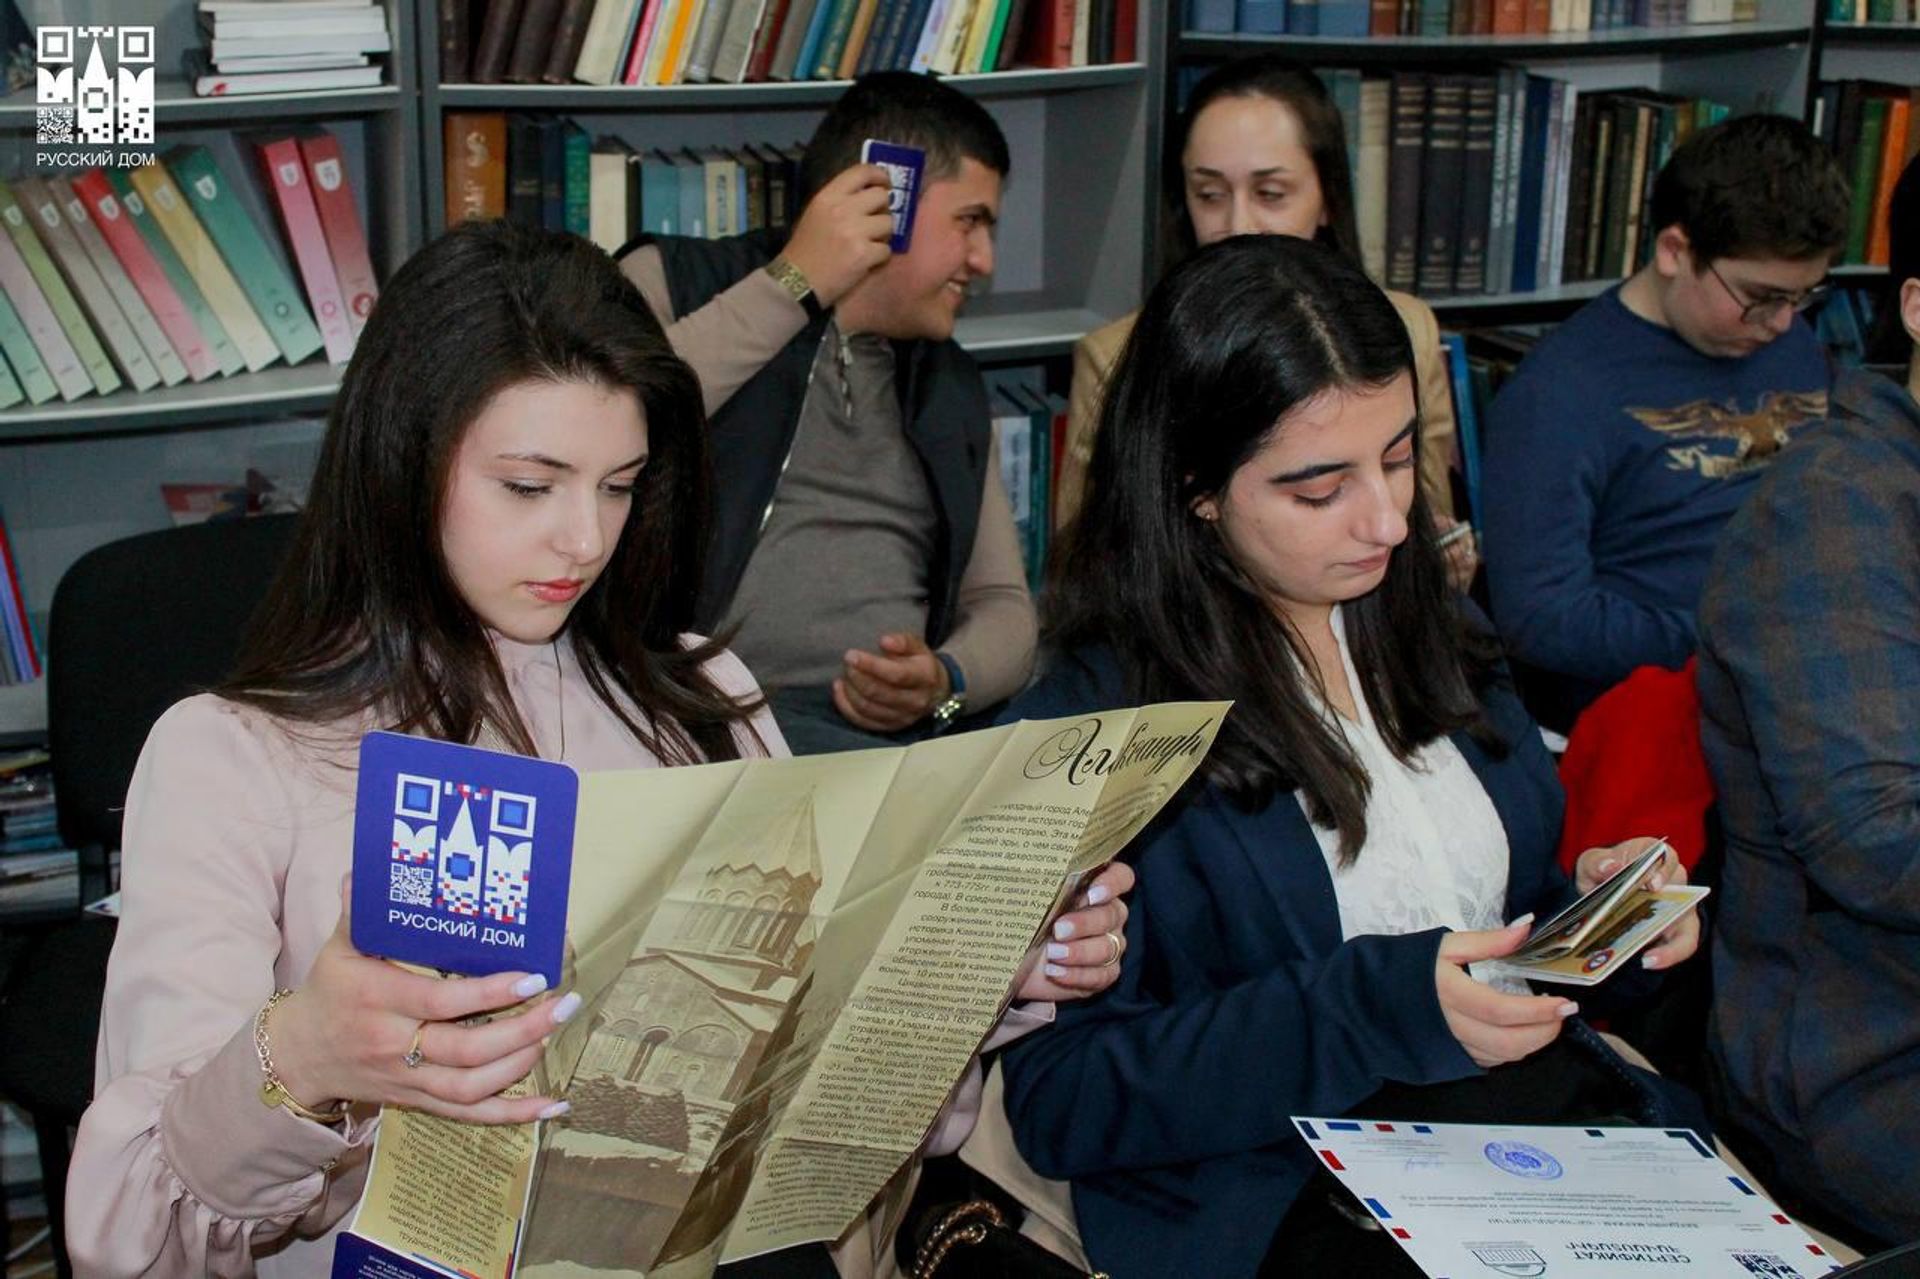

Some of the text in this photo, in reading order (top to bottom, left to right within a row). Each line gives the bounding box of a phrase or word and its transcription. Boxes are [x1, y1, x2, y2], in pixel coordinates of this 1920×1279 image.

[388, 910, 525, 948] РУССКИЙ ДОМ
[1574, 1252, 1691, 1264] СЕРТИФИКАТ
